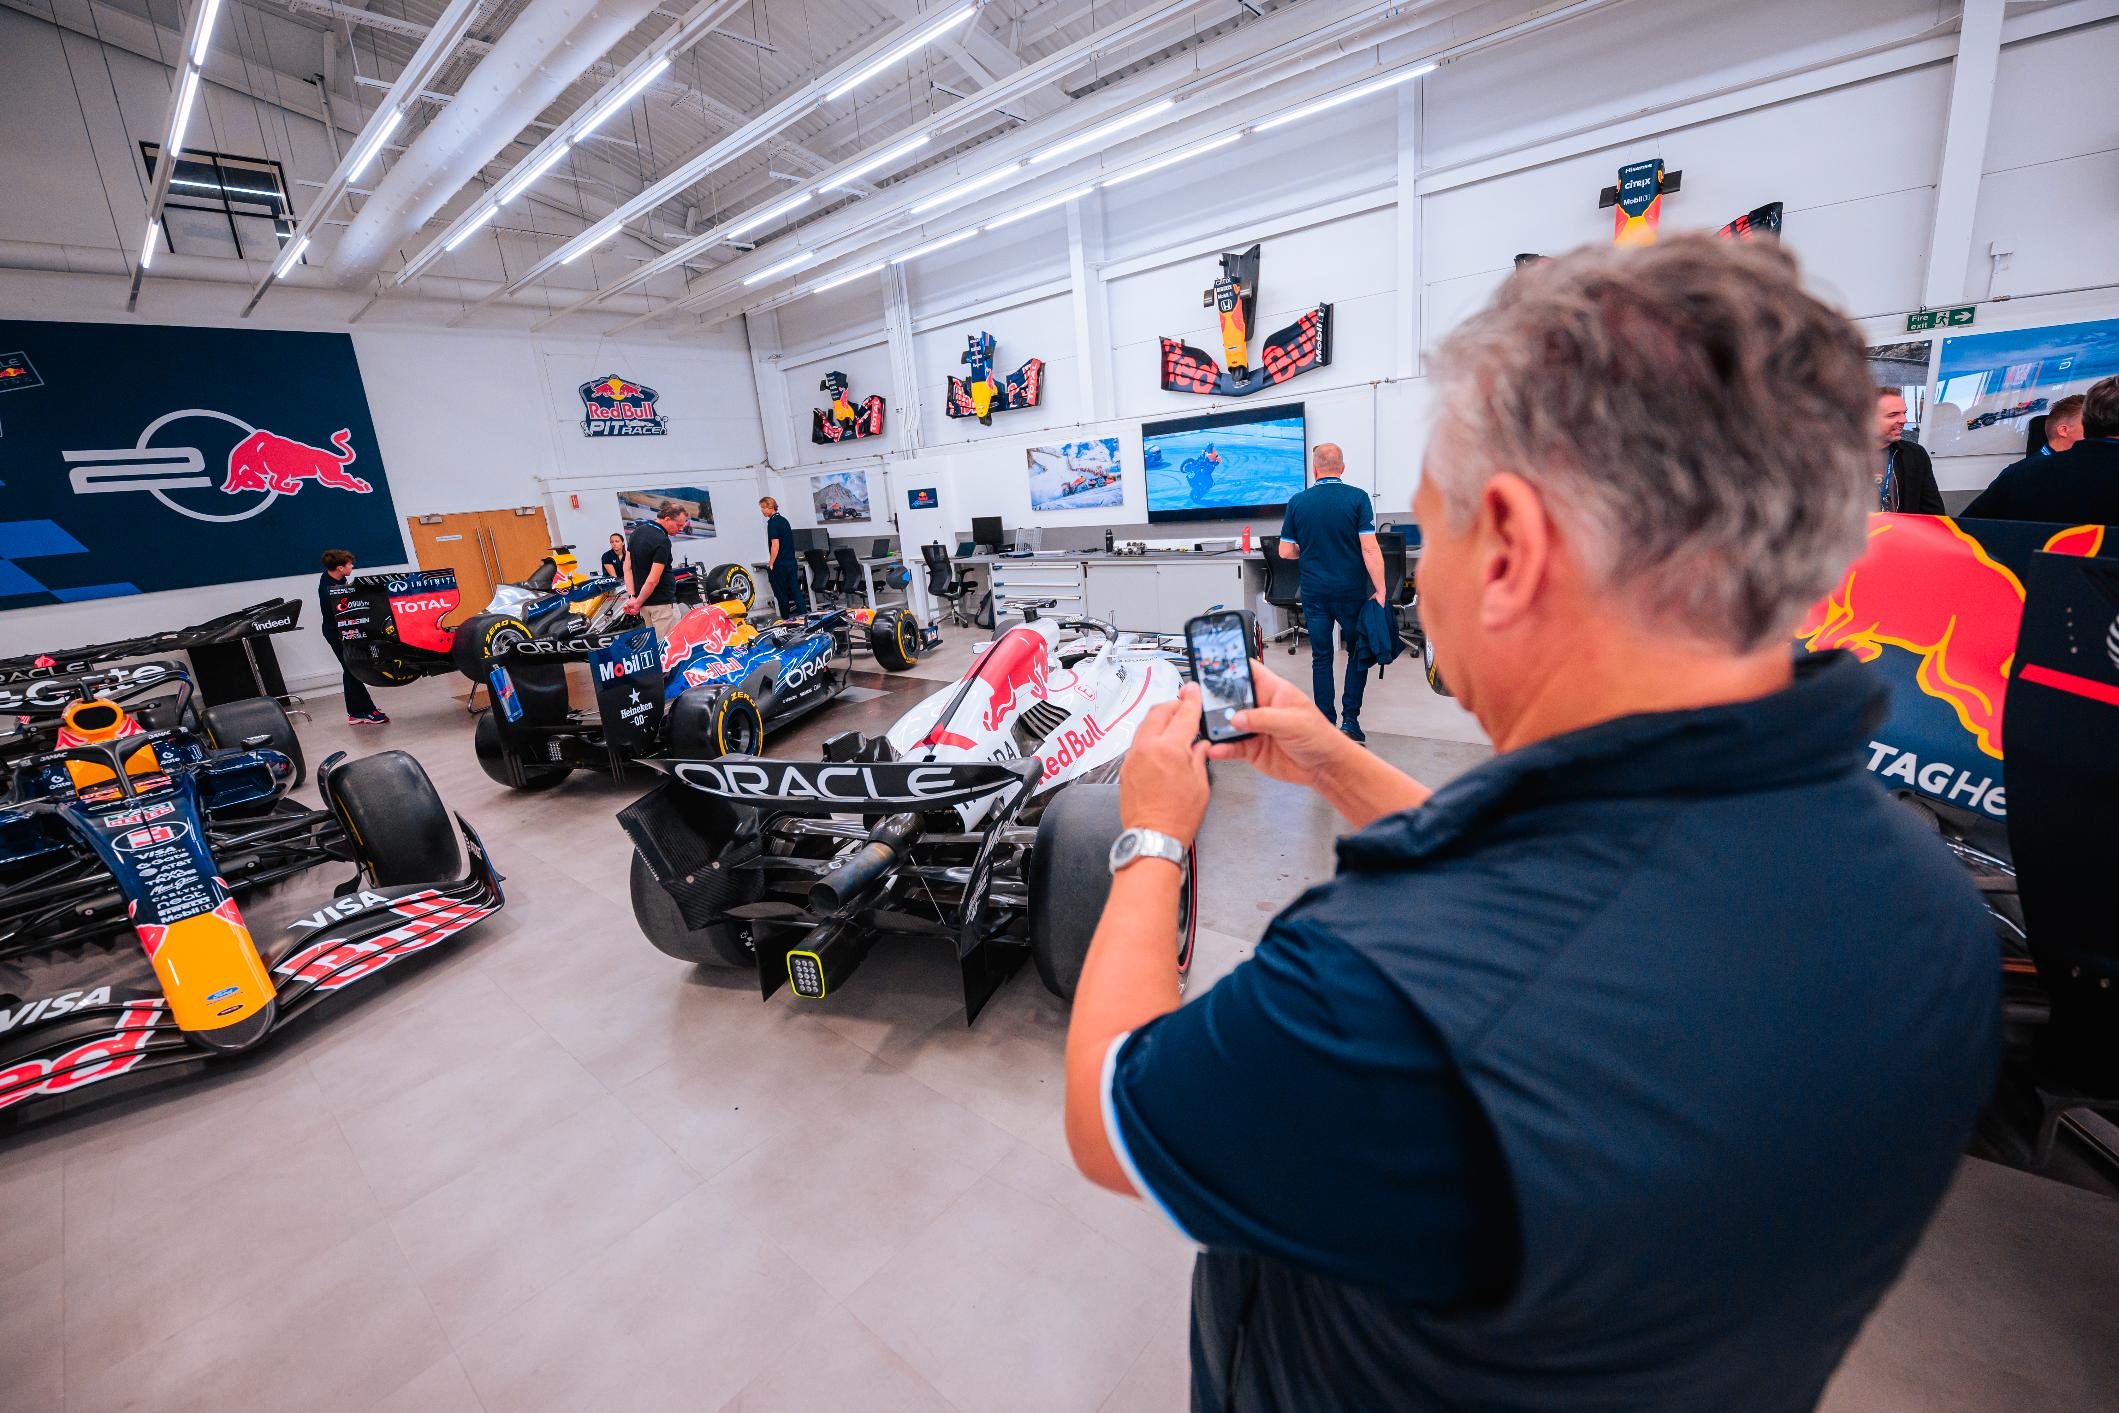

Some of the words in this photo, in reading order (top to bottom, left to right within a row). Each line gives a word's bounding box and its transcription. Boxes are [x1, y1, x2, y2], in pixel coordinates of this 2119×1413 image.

[1625, 163, 1653, 174] Hisense
[1623, 196, 1643, 206] Mobil
[1315, 322, 1323, 363] Mobil
[588, 402, 622, 419] Red
[621, 402, 654, 419] Bull
[870, 399, 880, 432] TOTAL
[589, 420, 625, 436] PIT
[622, 426, 662, 435] RACE
[411, 576, 456, 588] INFINITI
[392, 598, 453, 614] TOTAL
[253, 617, 291, 631] indeed
[484, 620, 509, 645] ZERO
[516, 637, 614, 654] ORACLE
[599, 656, 641, 682] Mobil
[682, 659, 719, 687] Red
[714, 656, 745, 680] Bull
[620, 702, 654, 720] Heineken
[148, 730, 171, 740] DAMAC
[1064, 713, 1106, 759] Bull
[40, 751, 68, 763] DAMAC
[160, 757, 180, 766] Gate
[49, 781, 71, 790] Gate
[674, 763, 956, 800] ORACLE
[133, 846, 178, 860] VISA
[160, 858, 193, 872] AT&T
[152, 884, 205, 903] CARLYLE
[157, 891, 206, 910] neat.
[161, 907, 200, 924] Mobil
[286, 890, 391, 930] VISA
[0, 986, 112, 1033] VISA
